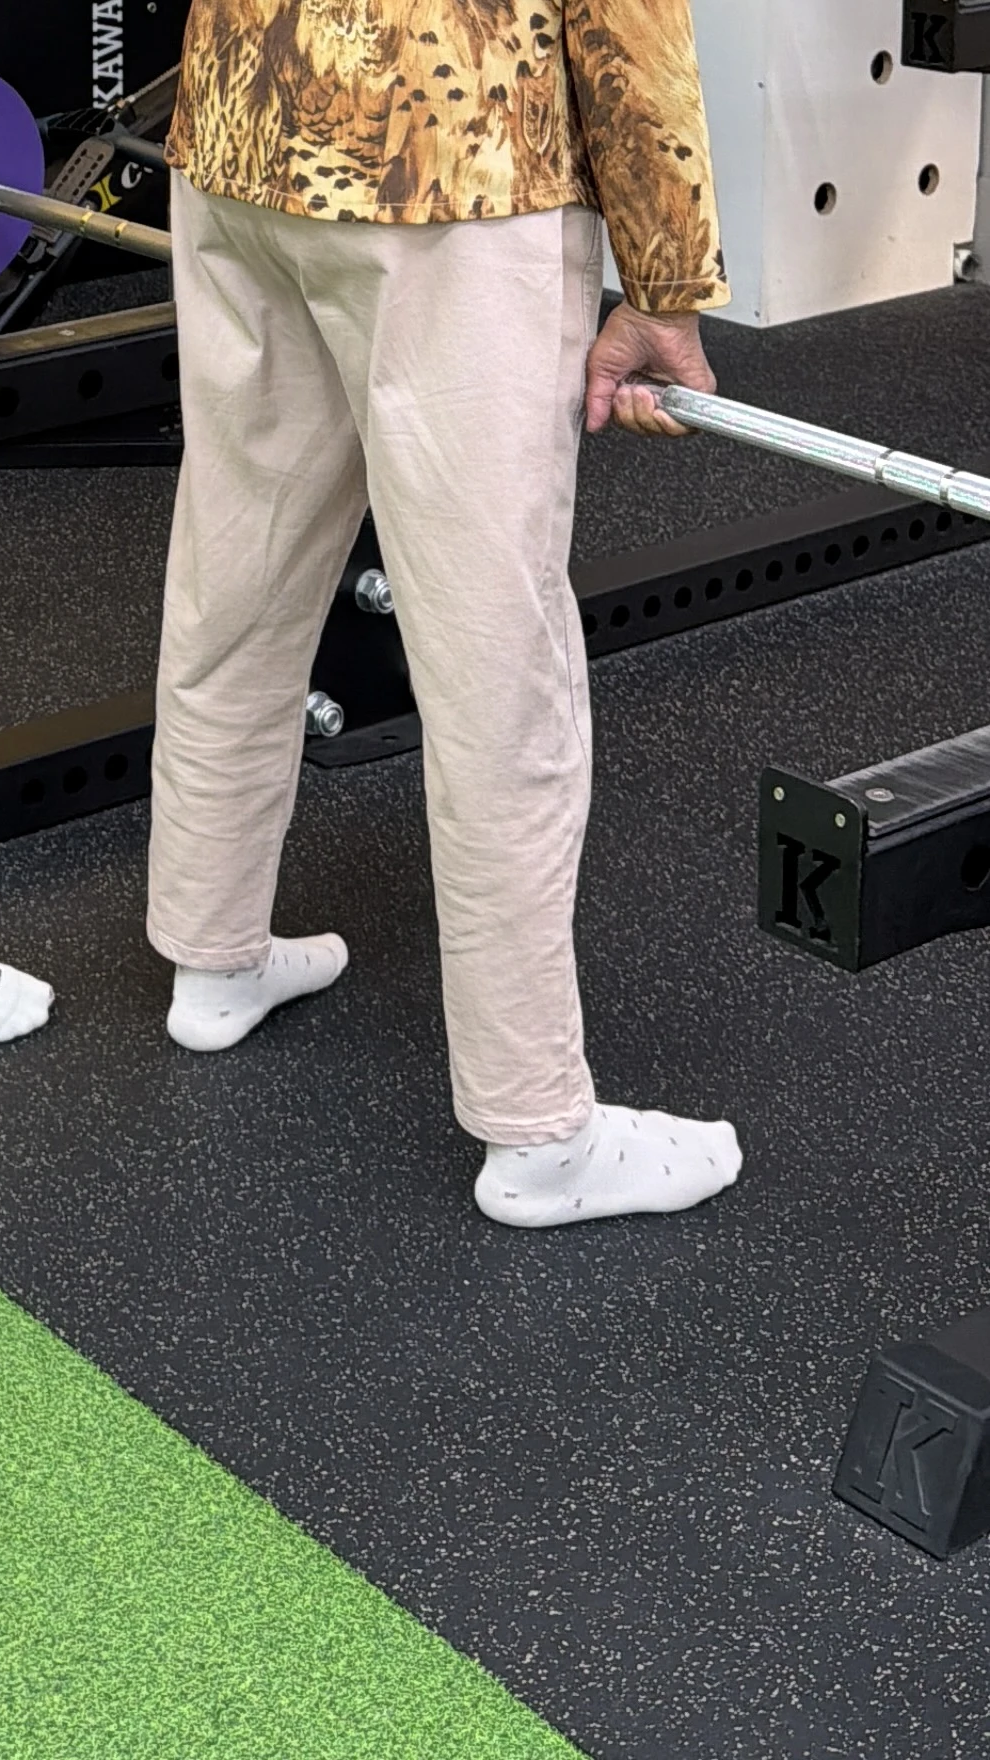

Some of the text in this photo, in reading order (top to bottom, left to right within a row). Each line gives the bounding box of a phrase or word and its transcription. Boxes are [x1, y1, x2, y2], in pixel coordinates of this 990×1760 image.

[910, 11, 949, 64] K
[774, 830, 842, 944] K
[849, 1373, 959, 1533] K
